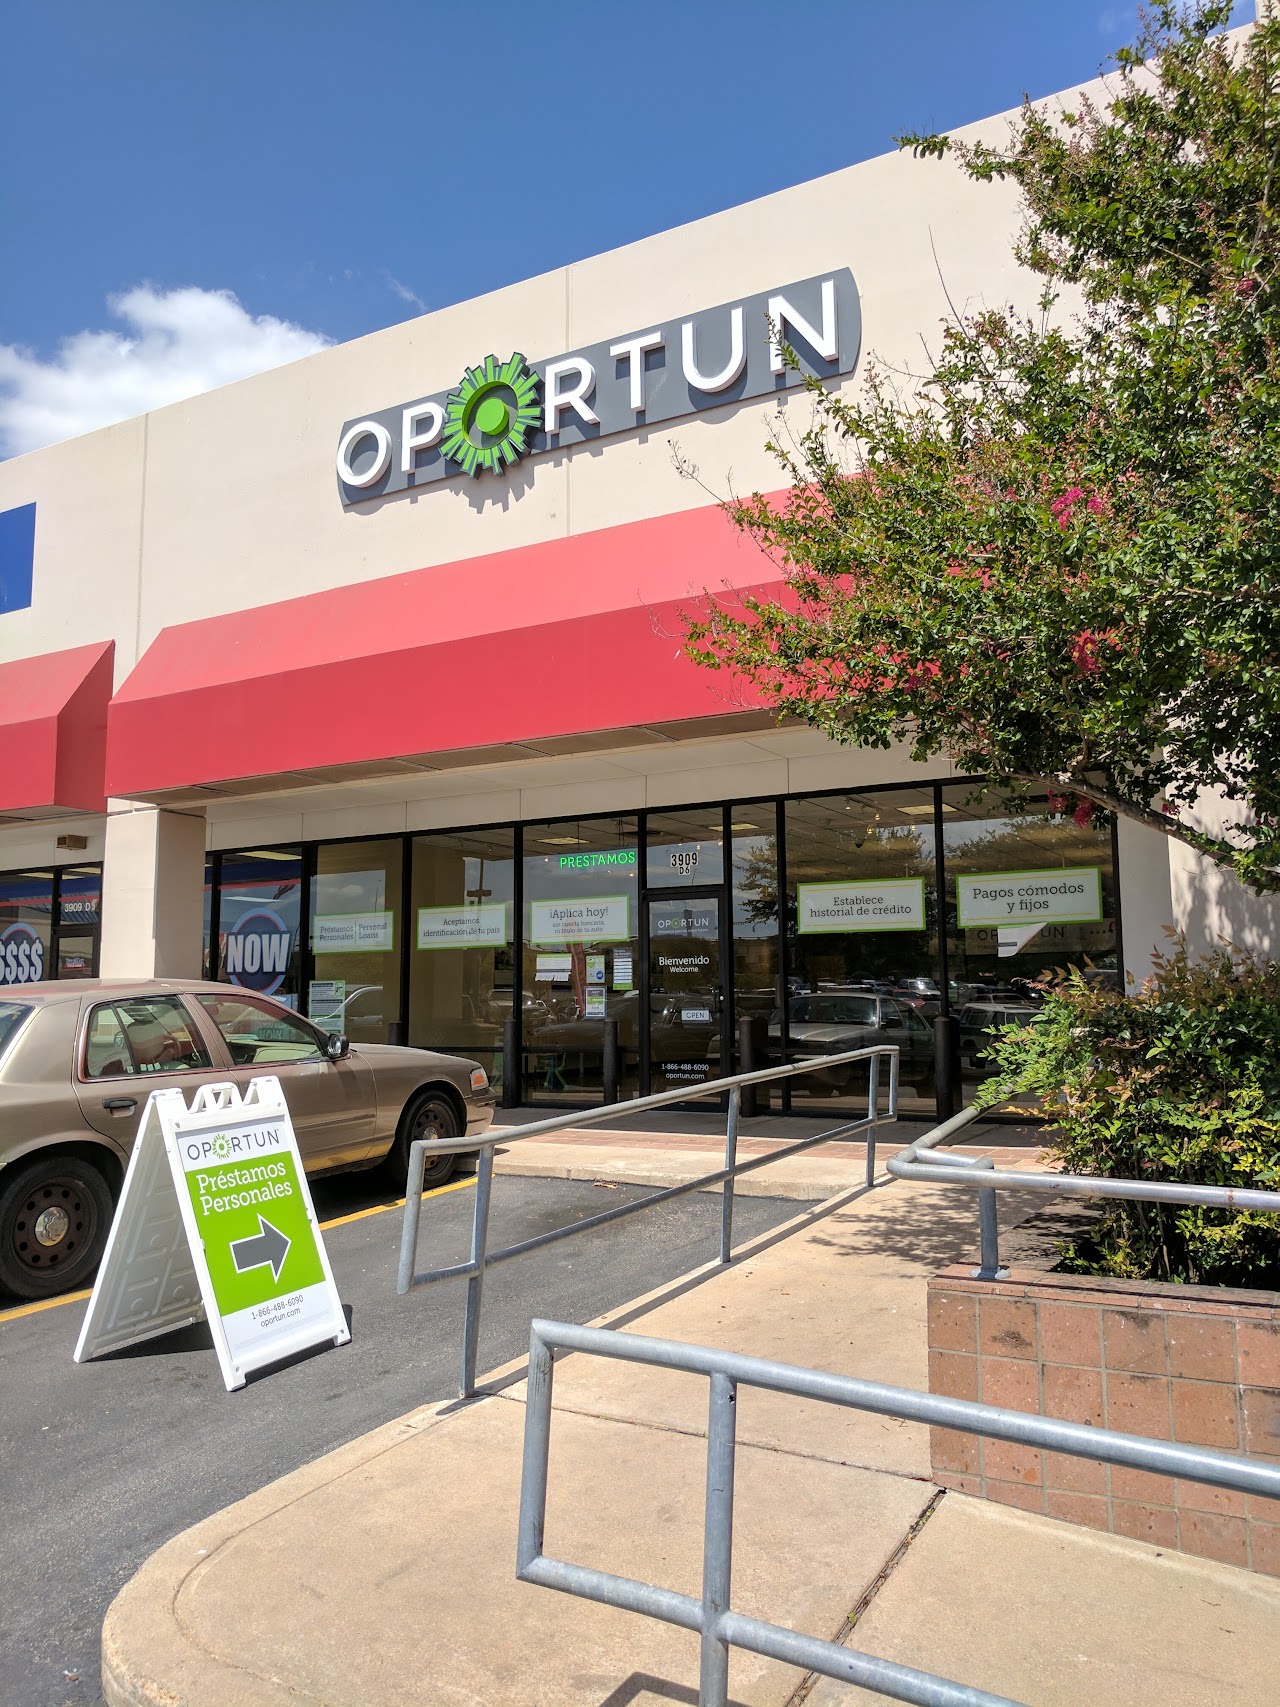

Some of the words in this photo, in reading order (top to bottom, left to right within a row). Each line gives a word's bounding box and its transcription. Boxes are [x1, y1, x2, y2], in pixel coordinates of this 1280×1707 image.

[336, 279, 839, 488] OPORTUN
[559, 851, 636, 869] PRESTAMOS
[671, 852, 698, 867] 3909
[679, 866, 690, 875] D6
[973, 888, 1014, 901] Pagos
[1017, 883, 1084, 897] cómodos
[833, 896, 884, 907] Establece
[1007, 901, 1015, 913] y
[1019, 899, 1049, 913] fijos
[586, 906, 609, 918] hoy!
[810, 907, 854, 918] historial
[856, 906, 870, 916] de
[872, 904, 912, 915] crédito
[358, 922, 388, 933] Personal
[442, 918, 480, 927] Aceptamos
[658, 917, 709, 929] OPORTUN
[319, 933, 354, 942] Personales
[358, 932, 379, 940] Loans
[468, 926, 478, 936] de
[226, 933, 291, 973] NOW
[659, 955, 710, 967] Bienvenido
[686, 1011, 705, 1019] OPEN
[661, 1063, 709, 1071] 1-866-488-6090
[187, 1129, 280, 1160] OPORTUN
[196, 1162, 287, 1194] Préstamos
[200, 1181, 293, 1216] Personales
[251, 1294, 304, 1320] 1-866-488-6090
[260, 1307, 301, 1328] oportun.com
